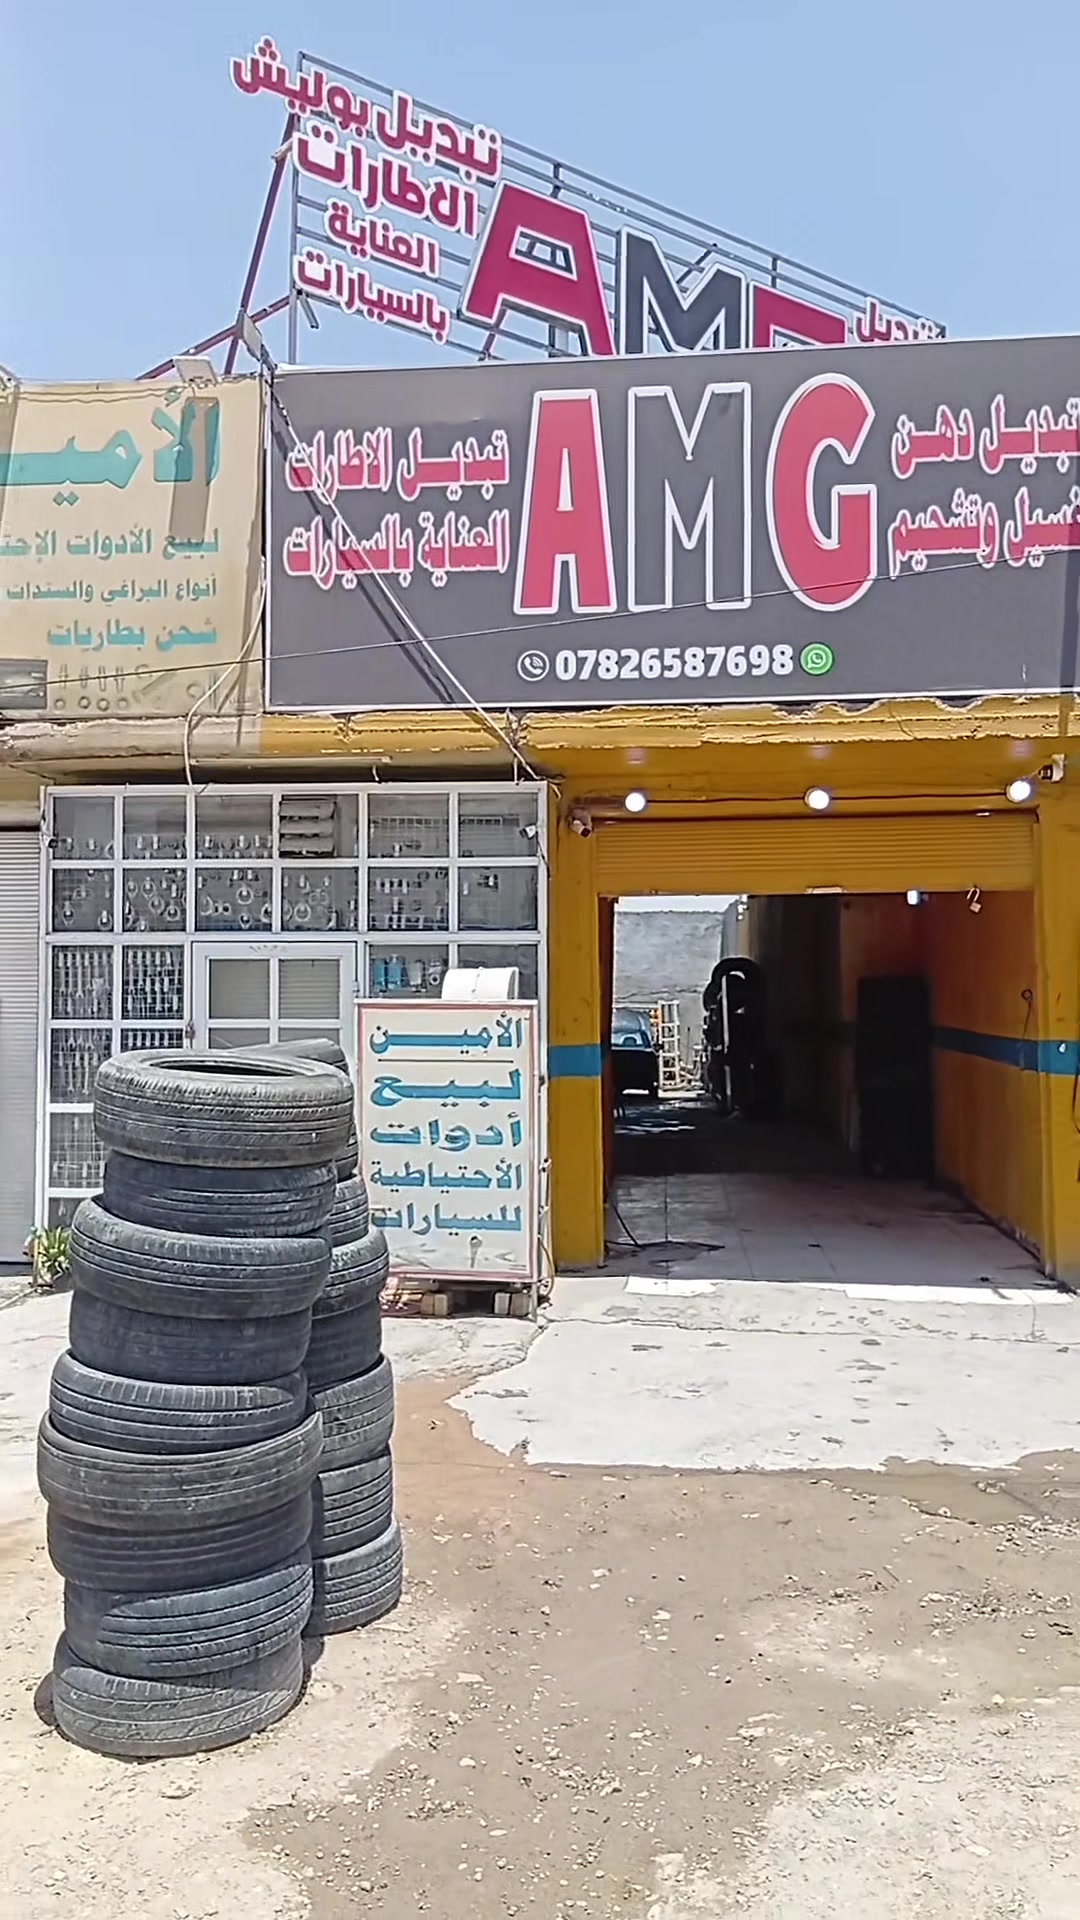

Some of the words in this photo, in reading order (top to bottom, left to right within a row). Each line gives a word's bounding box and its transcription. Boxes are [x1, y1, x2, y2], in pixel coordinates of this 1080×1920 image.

[230, 36, 371, 138] بوليش
[373, 90, 501, 182] تبديل
[326, 200, 440, 278] العناية
[294, 250, 450, 345] بالسيارات
[0, 386, 220, 506] الأمي
[398, 427, 510, 501] تبديل
[891, 404, 974, 479] دهن
[513, 372, 878, 614] AMG
[163, 527, 219, 560] لبيع
[283, 513, 414, 590] بالسيارات
[417, 508, 510, 587] العناية
[887, 487, 999, 580] وتشحيم
[47, 619, 145, 652] بطاريات
[155, 617, 217, 652] شحن
[555, 645, 794, 681] 07826587698
[370, 1011, 523, 1054] الأمين
[370, 1068, 521, 1107] لبيع
[370, 1111, 522, 1151] أدوات
[370, 1202, 522, 1237] للسيارات
